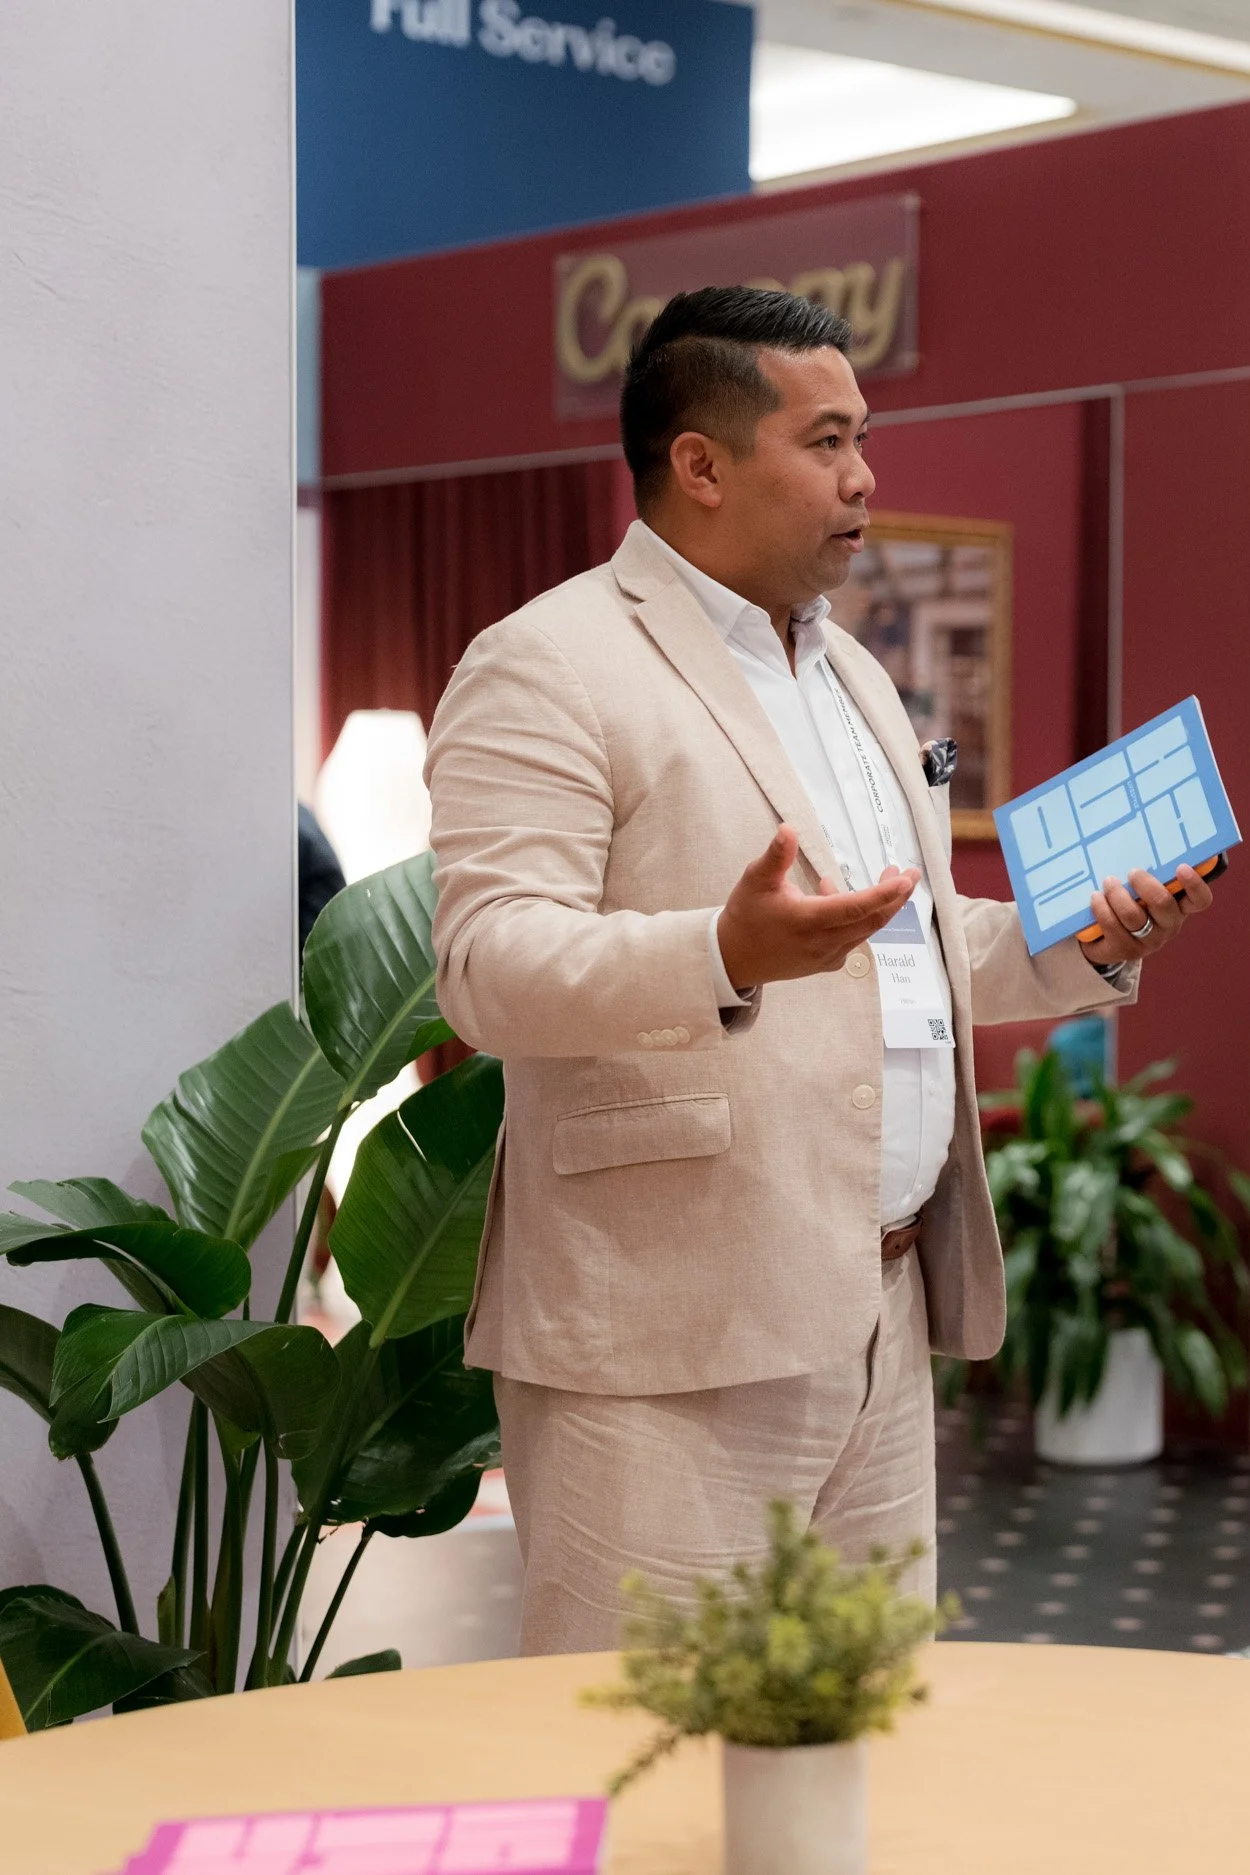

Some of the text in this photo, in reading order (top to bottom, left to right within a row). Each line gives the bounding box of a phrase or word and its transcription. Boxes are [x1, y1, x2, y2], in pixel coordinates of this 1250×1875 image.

[478, 0, 677, 86] Service
[861, 754, 884, 813] CORPORATE
[877, 954, 916, 968] Harald
[891, 973, 911, 984] Han
